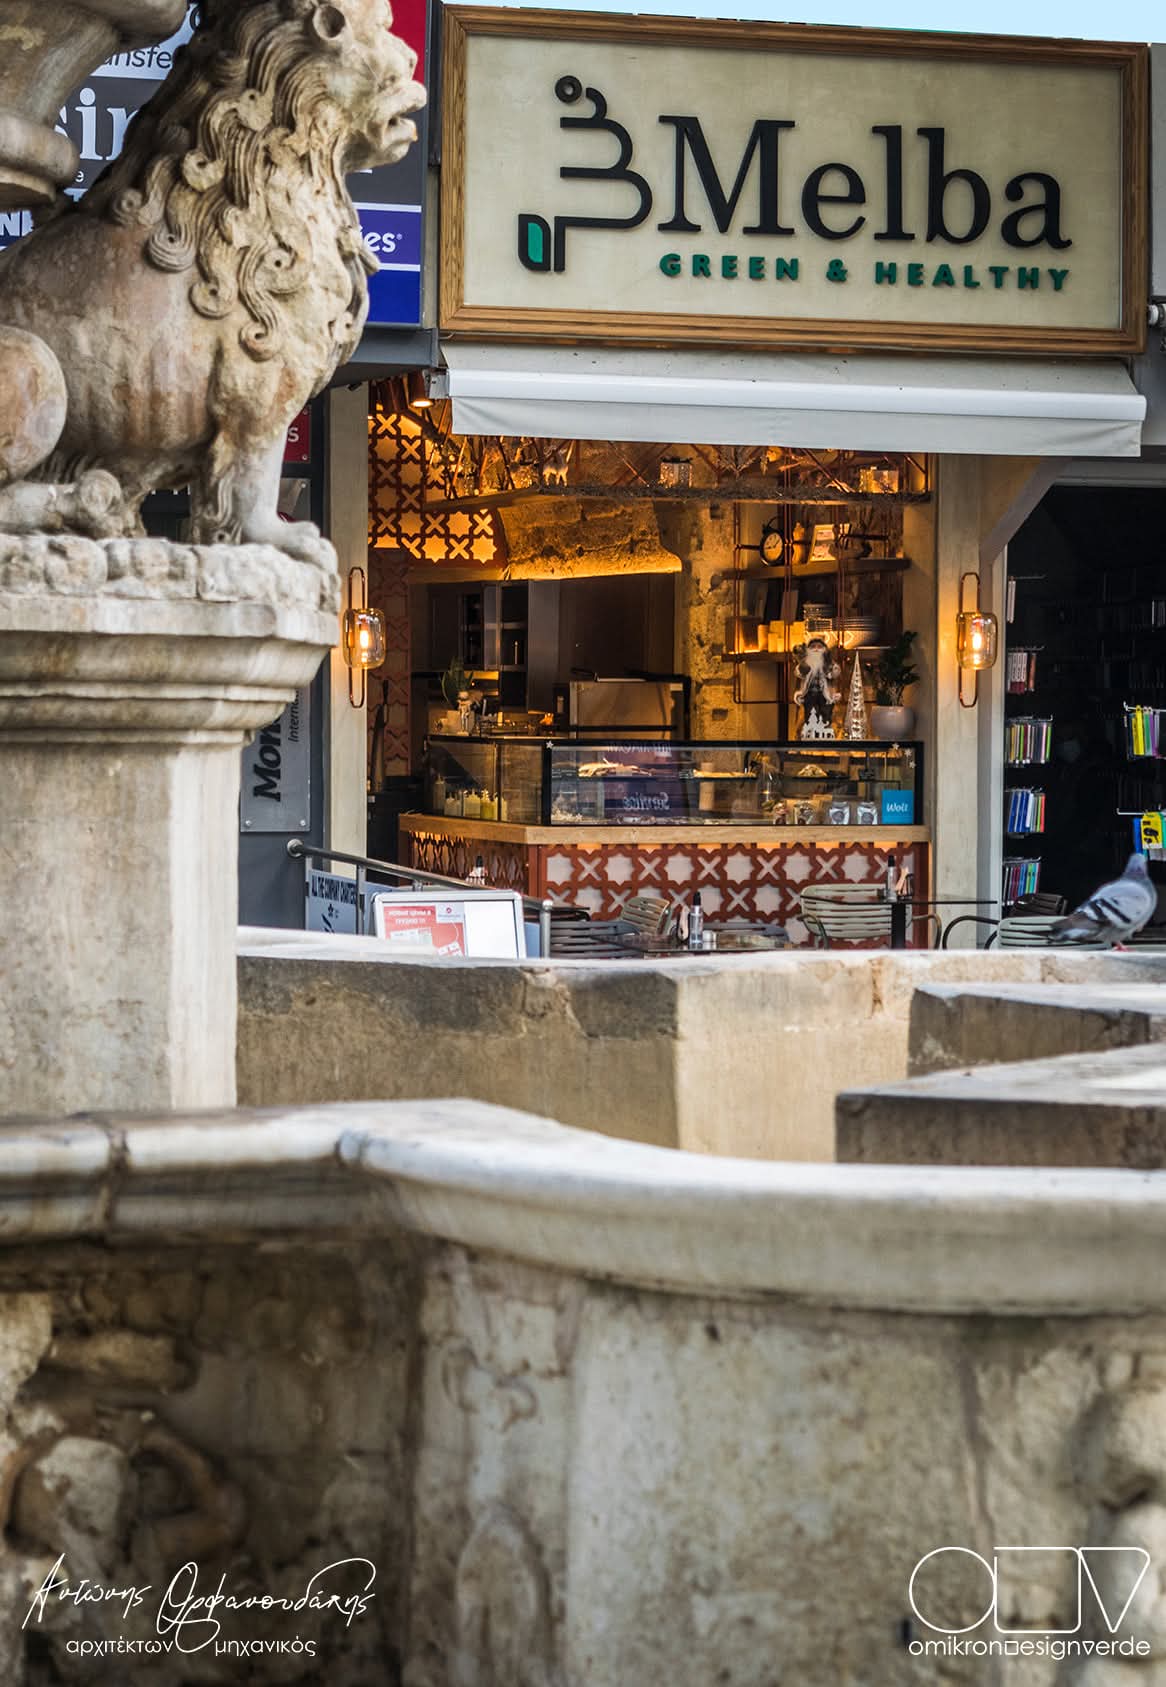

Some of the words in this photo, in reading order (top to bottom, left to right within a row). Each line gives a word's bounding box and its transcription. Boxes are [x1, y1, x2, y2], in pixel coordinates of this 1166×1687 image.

[657, 114, 1073, 249] Melba
[359, 225, 397, 253] es
[659, 252, 800, 281] GREEN
[826, 258, 848, 283] &
[875, 261, 1071, 291] HEALTHY
[252, 714, 281, 802] Mon
